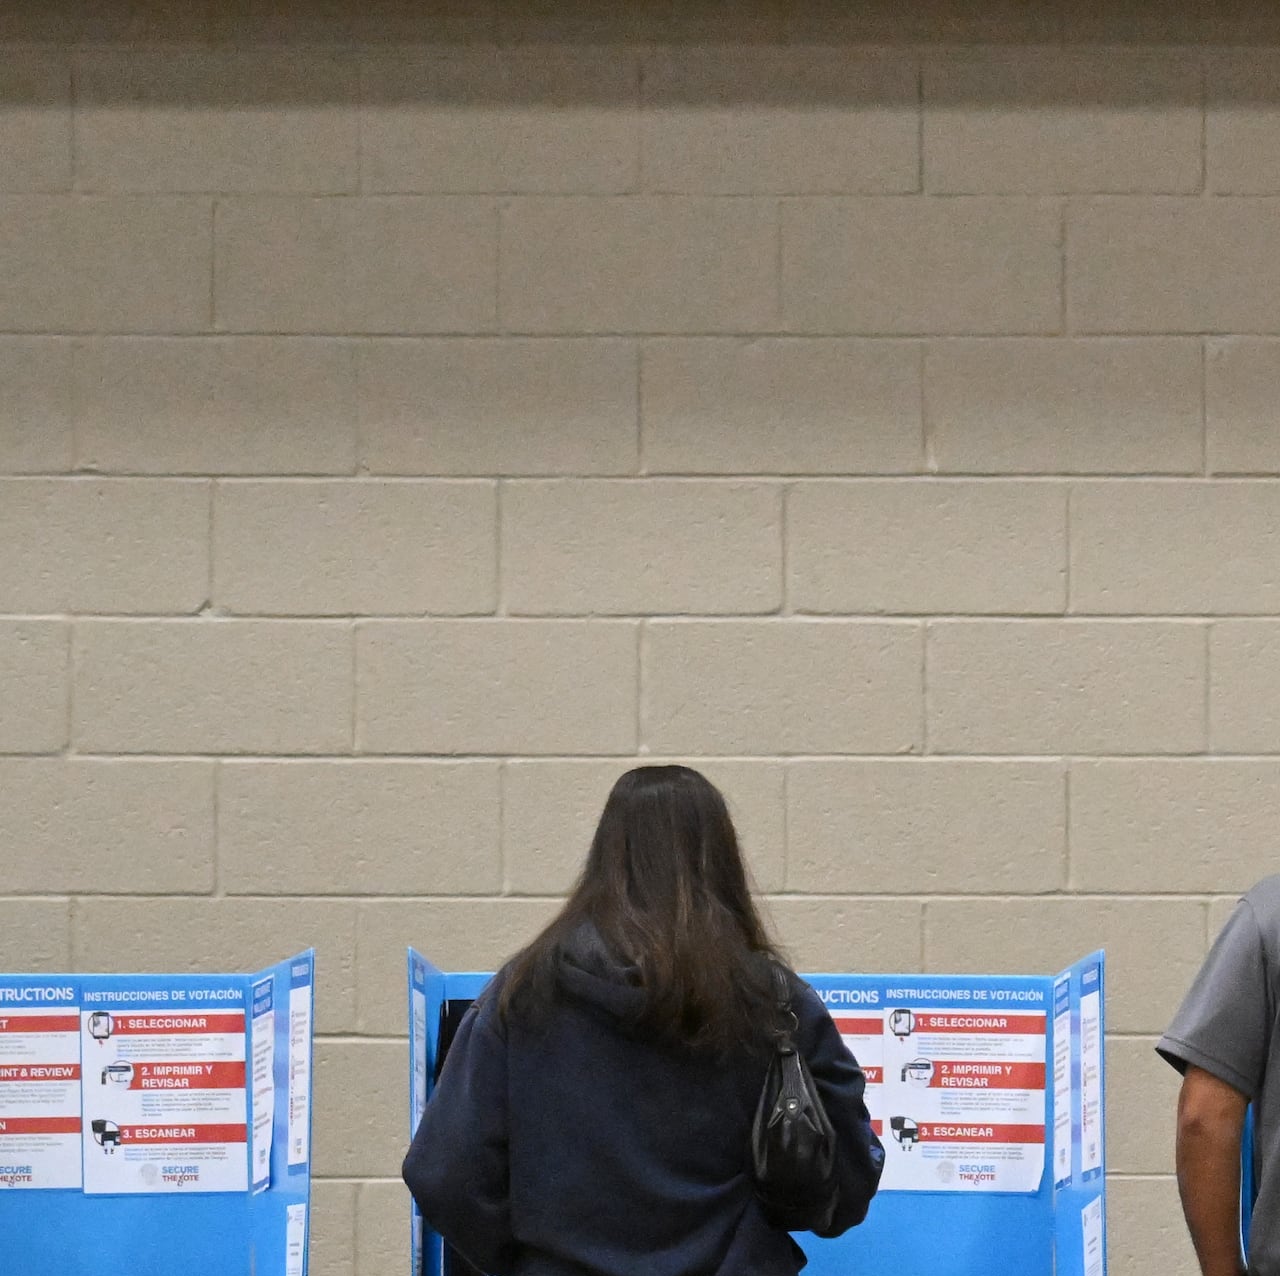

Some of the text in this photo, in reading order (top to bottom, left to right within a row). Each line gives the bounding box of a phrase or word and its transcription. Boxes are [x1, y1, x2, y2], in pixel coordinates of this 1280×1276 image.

[84, 987, 242, 1002] INSTRUCCIONES DE VOTACIÓN
[816, 989, 879, 1003] UCTIONS
[886, 989, 970, 1000] INSTRUCCIONES
[972, 989, 986, 1000] DE
[990, 988, 1043, 1001] VOTACIÓN
[117, 1018, 207, 1029] 1. SELECCIONAR
[918, 1018, 1007, 1028] 1. SELECCIONAR
[0, 1067, 74, 1077] INT & REVIEW
[141, 1065, 213, 1076] 2. IMPRIMIR Y
[941, 1065, 1012, 1076] 2. IMPRIMIR Y
[142, 1078, 189, 1088] REVISAR
[941, 1077, 988, 1087] REVISAR
[123, 1128, 196, 1139] 3. ESCANEAR
[921, 1127, 993, 1137] 3. ESCANEAR
[162, 1166, 199, 1175] SECURE
[959, 1164, 995, 1173] SECURE
